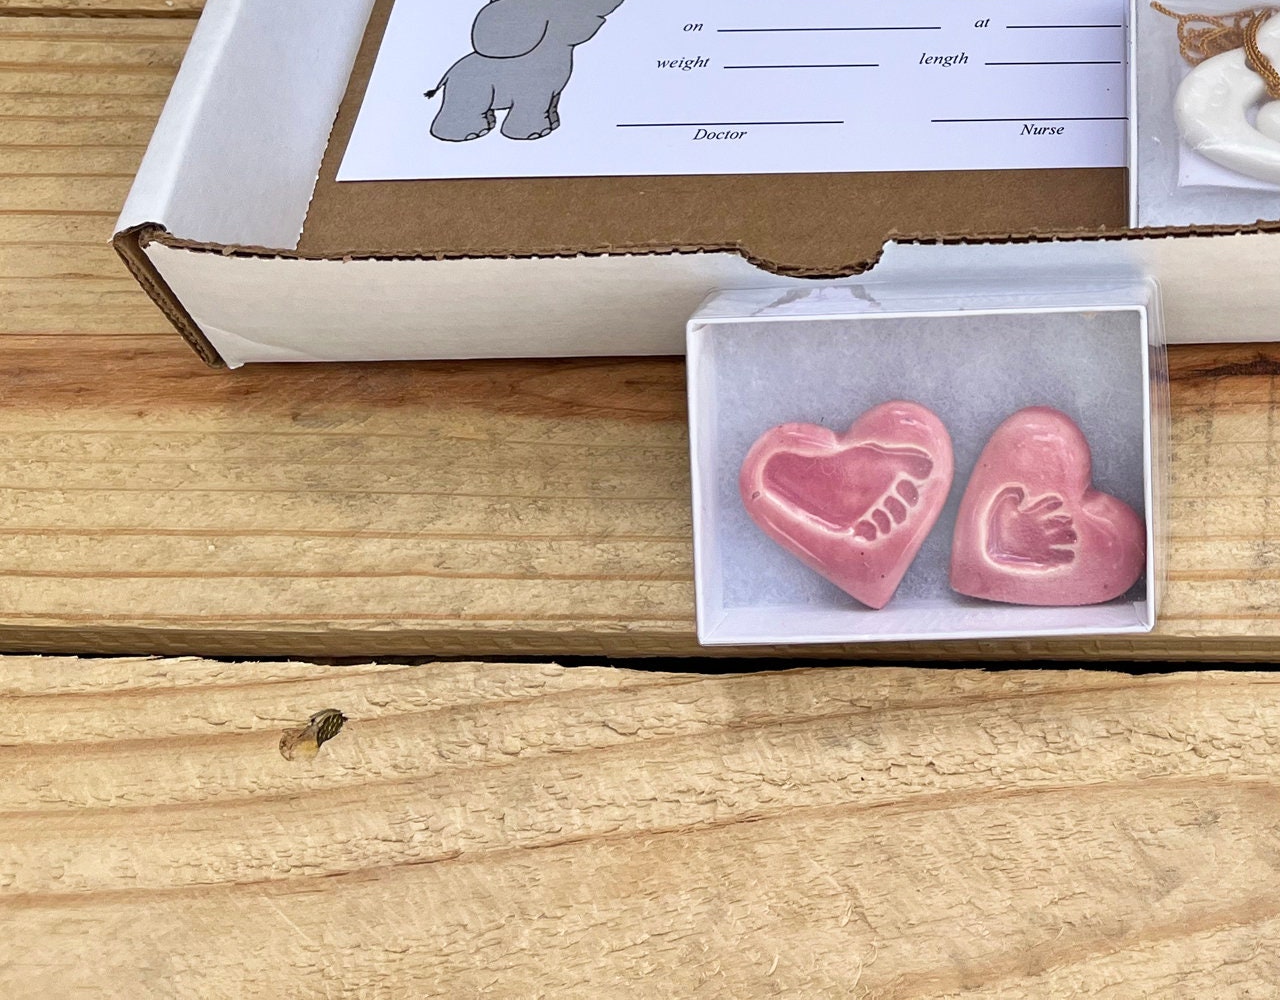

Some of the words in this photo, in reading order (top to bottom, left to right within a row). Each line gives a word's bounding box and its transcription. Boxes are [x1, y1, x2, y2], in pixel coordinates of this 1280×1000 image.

[683, 23, 704, 32] on
[974, 18, 990, 28] at
[657, 55, 710, 71] weight
[919, 52, 969, 68] length
[693, 128, 748, 140] Doctor
[1020, 123, 1065, 136] Nurse
